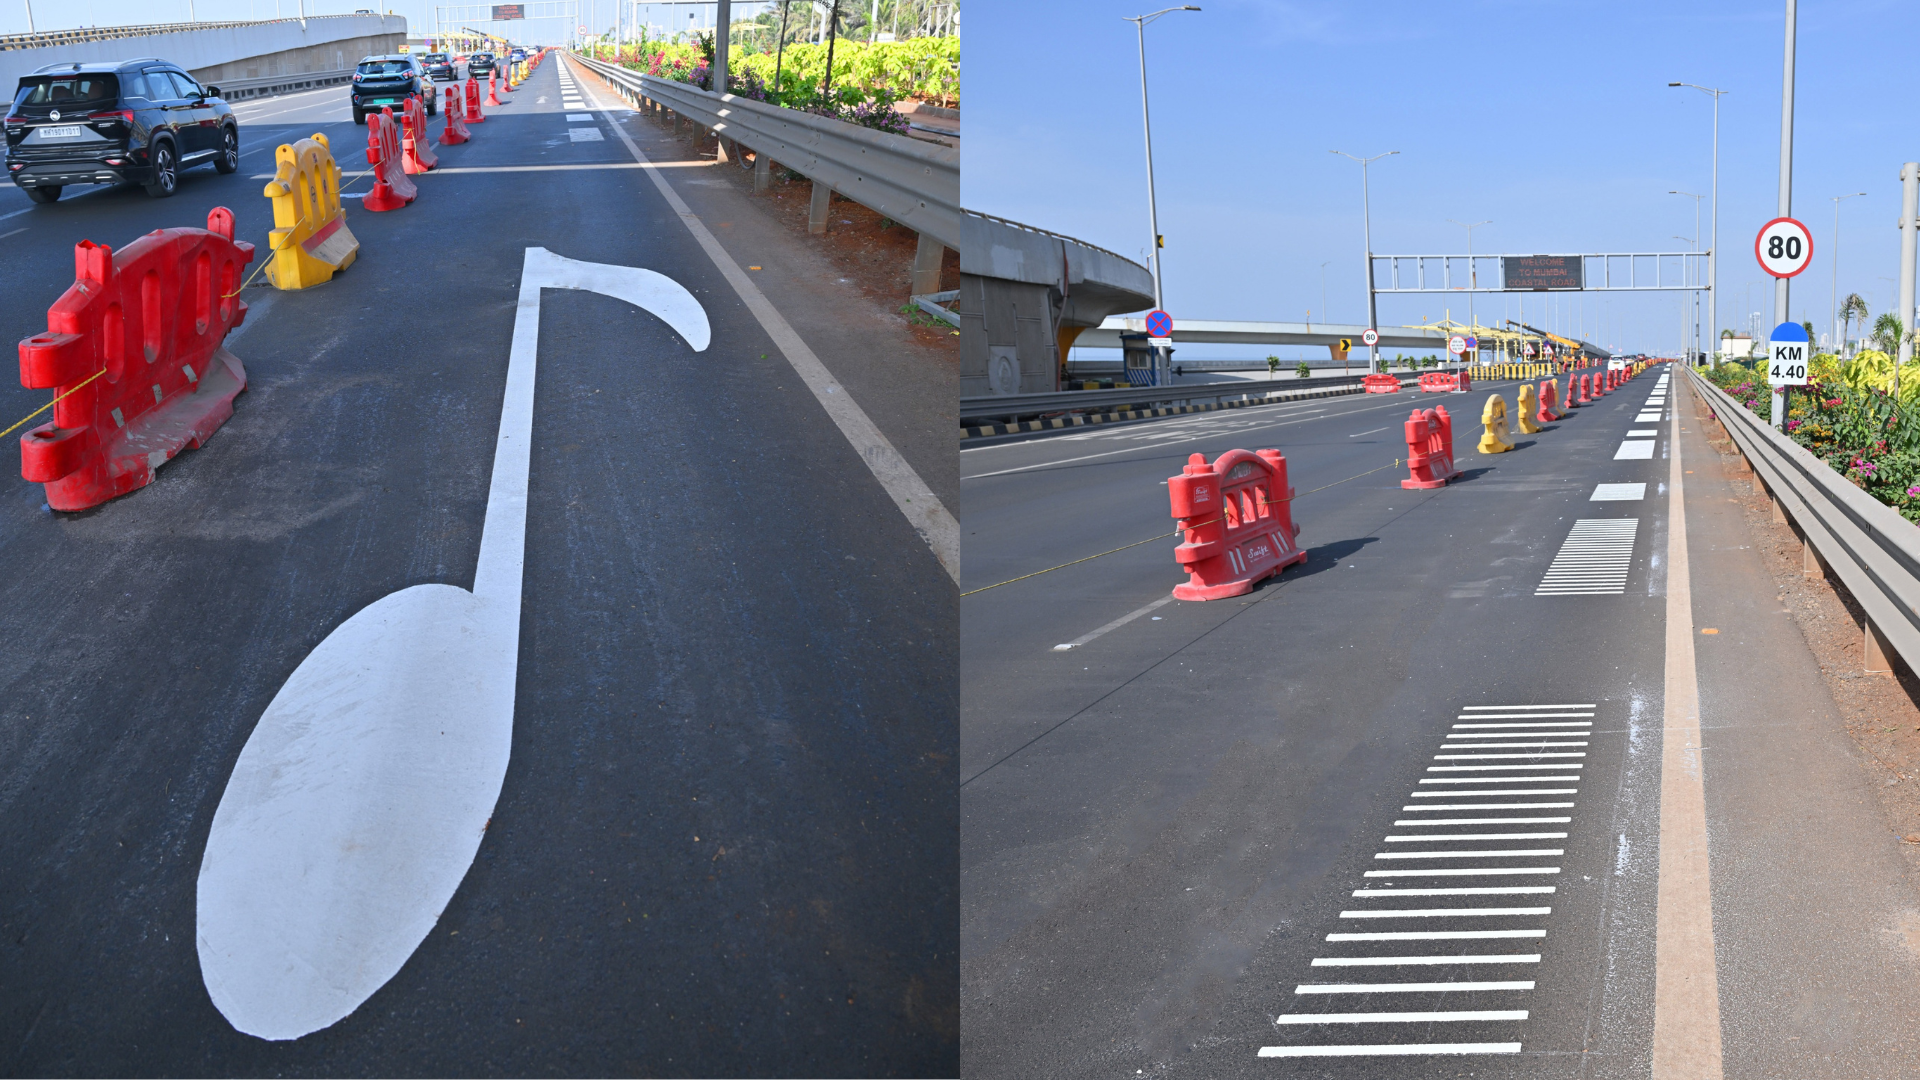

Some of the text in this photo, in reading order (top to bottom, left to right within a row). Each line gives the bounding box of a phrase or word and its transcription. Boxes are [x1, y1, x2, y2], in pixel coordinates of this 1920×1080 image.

[1768, 236, 1801, 260] 80
[1520, 258, 1565, 266] WELCOME
[1776, 346, 1802, 360] KM
[1771, 365, 1804, 378] 4.40
[1248, 546, 1268, 558] Swift
